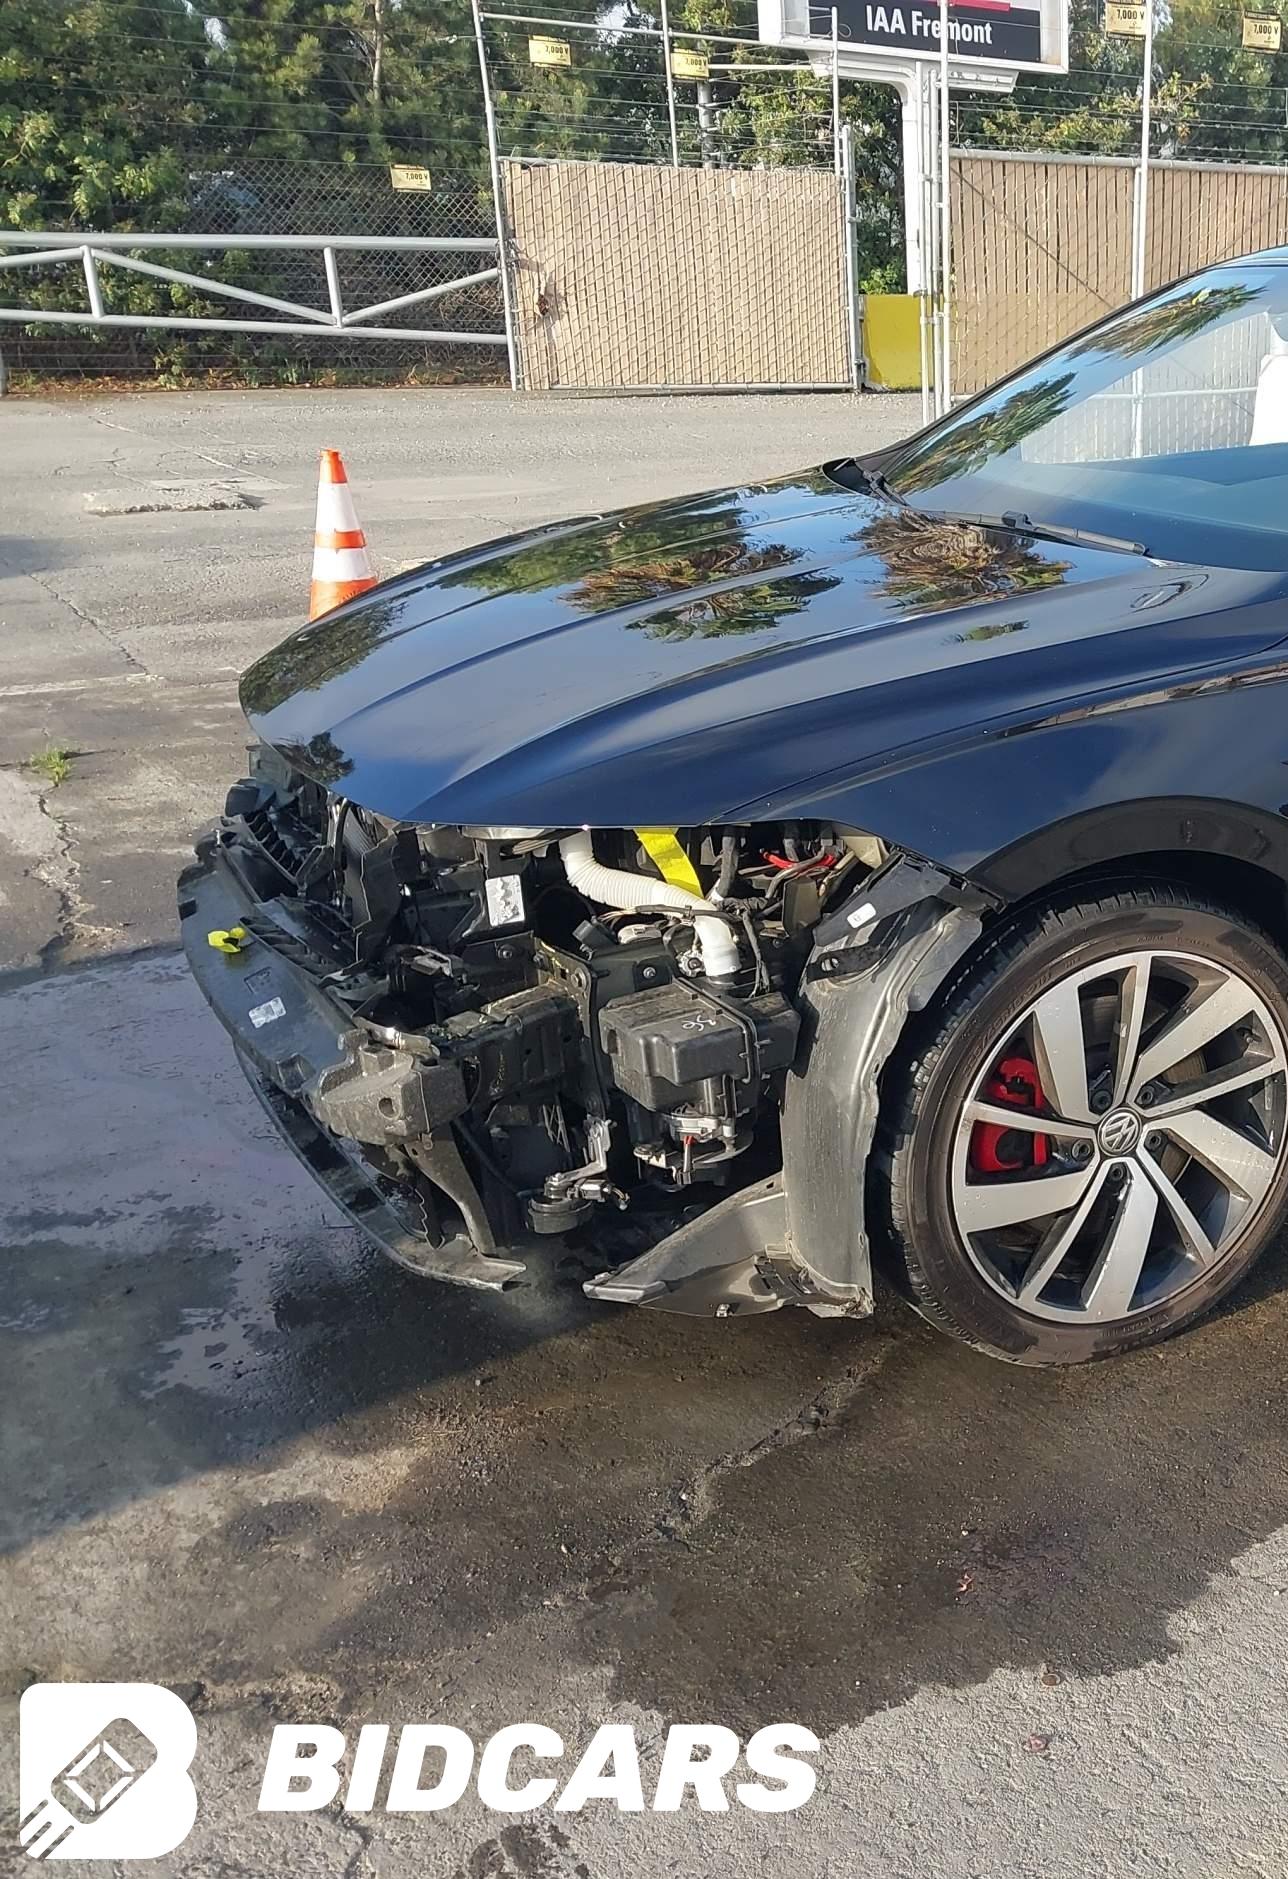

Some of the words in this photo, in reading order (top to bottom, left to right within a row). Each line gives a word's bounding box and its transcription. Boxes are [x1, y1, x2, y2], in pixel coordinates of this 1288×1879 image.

[1116, 9, 1137, 20] 7,000
[1139, 11, 1145, 20] V
[866, 5, 906, 35] IAA
[911, 10, 993, 45] Fremont
[1253, 24, 1272, 35] 7,000
[1274, 26, 1279, 35] V
[405, 172, 423, 181] 7,000
